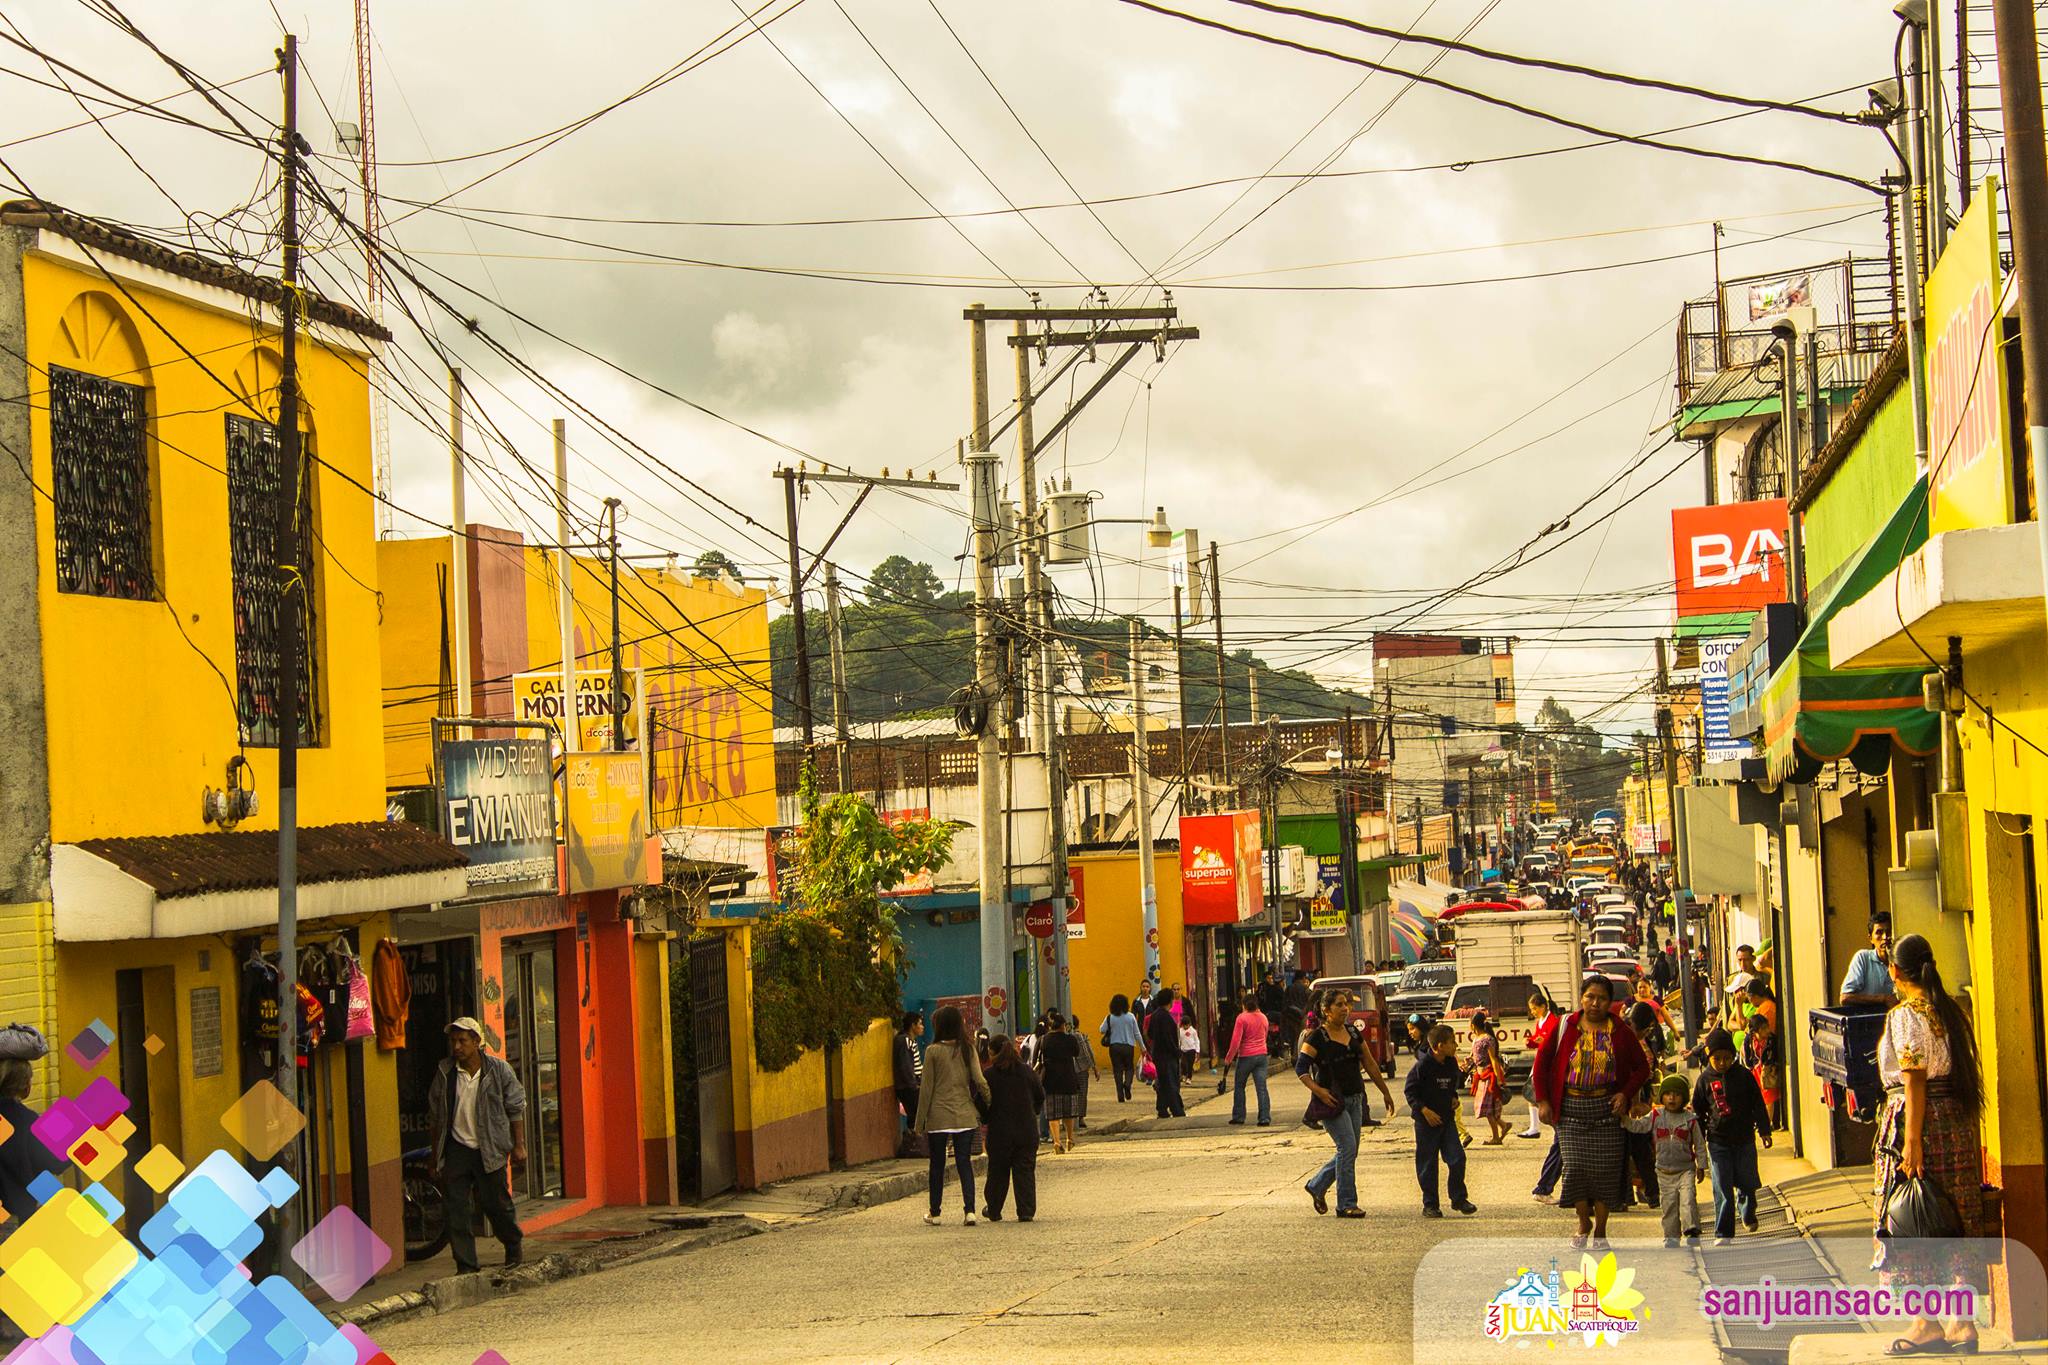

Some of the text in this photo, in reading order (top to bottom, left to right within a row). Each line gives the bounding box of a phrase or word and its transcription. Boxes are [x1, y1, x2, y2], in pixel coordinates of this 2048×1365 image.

[530, 677, 616, 695] CALAD
[522, 692, 632, 719] MOERNO
[448, 793, 552, 846] EMANUEL
[1185, 868, 1232, 880] superpan
[1027, 913, 1052, 926] Claro
[1455, 1028, 1532, 1044] TOOTA
